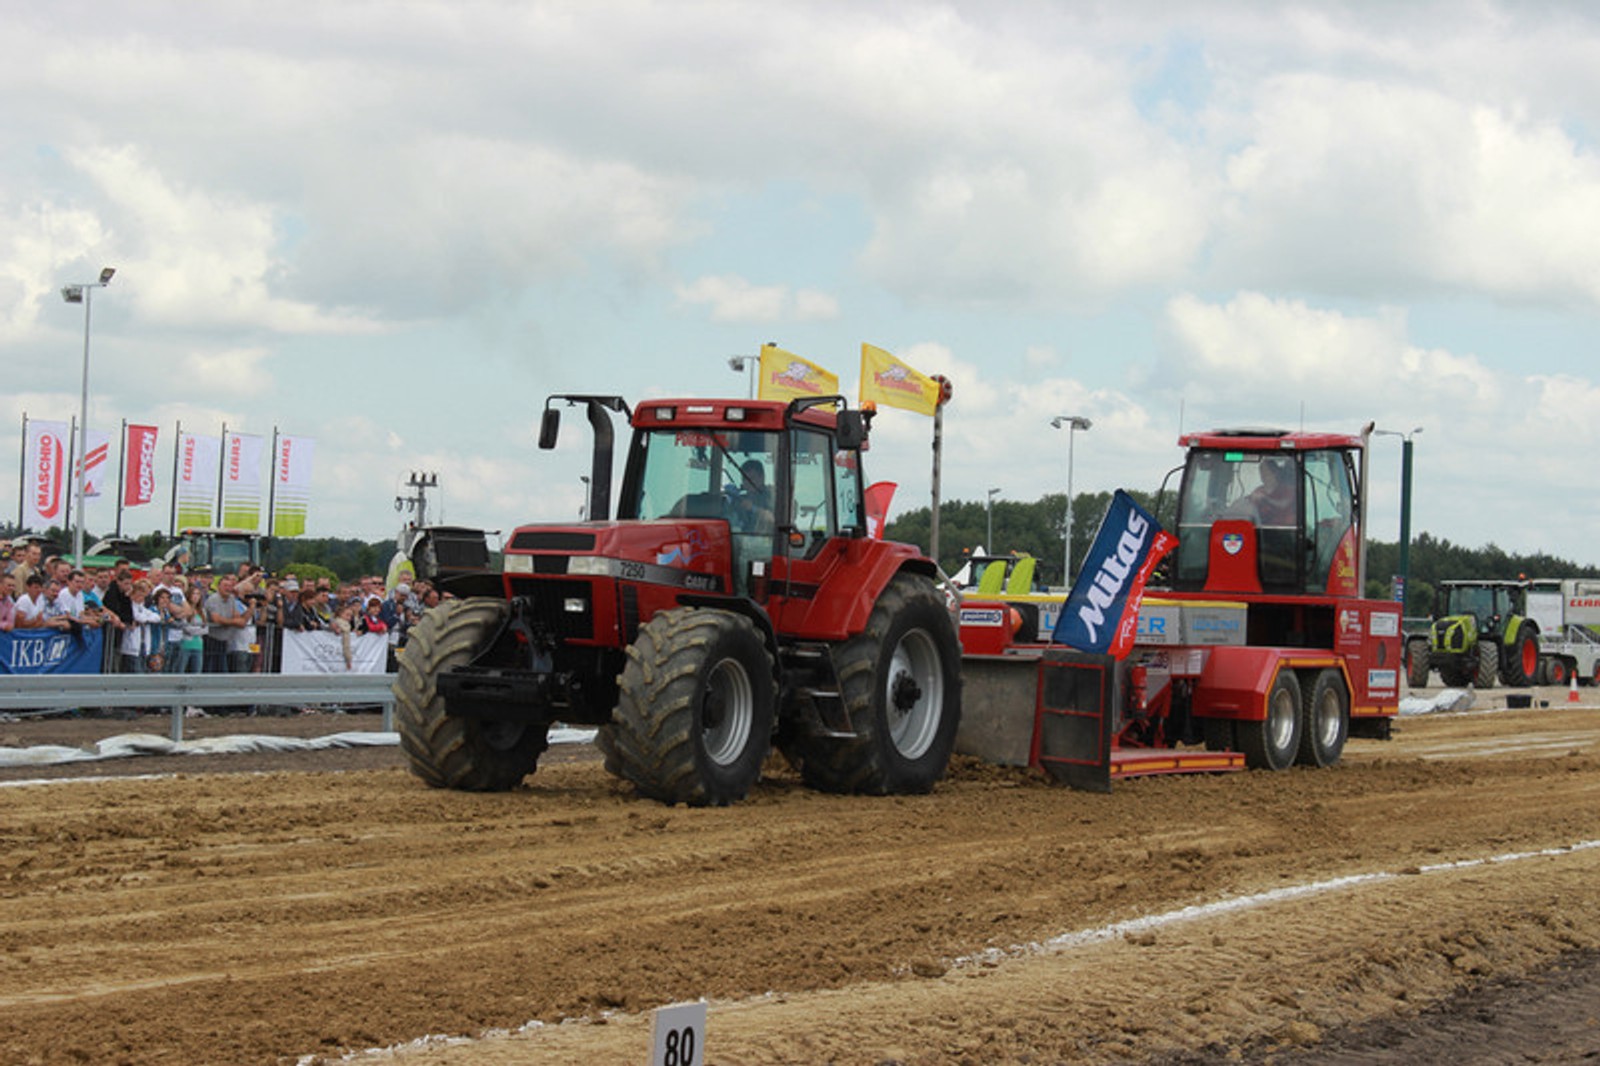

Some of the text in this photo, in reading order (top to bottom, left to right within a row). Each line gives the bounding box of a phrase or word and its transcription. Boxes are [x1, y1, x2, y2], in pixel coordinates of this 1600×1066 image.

[37, 434, 53, 507] MASCHIO
[138, 430, 155, 502] HORSCH
[183, 437, 195, 482] CLAAS
[229, 437, 241, 481] CLAAS
[280, 439, 291, 482] CLAAS
[620, 561, 645, 579] 7250
[1078, 508, 1150, 644] Mitas
[11, 639, 45, 669] IKB
[664, 1026, 695, 1066] 80
